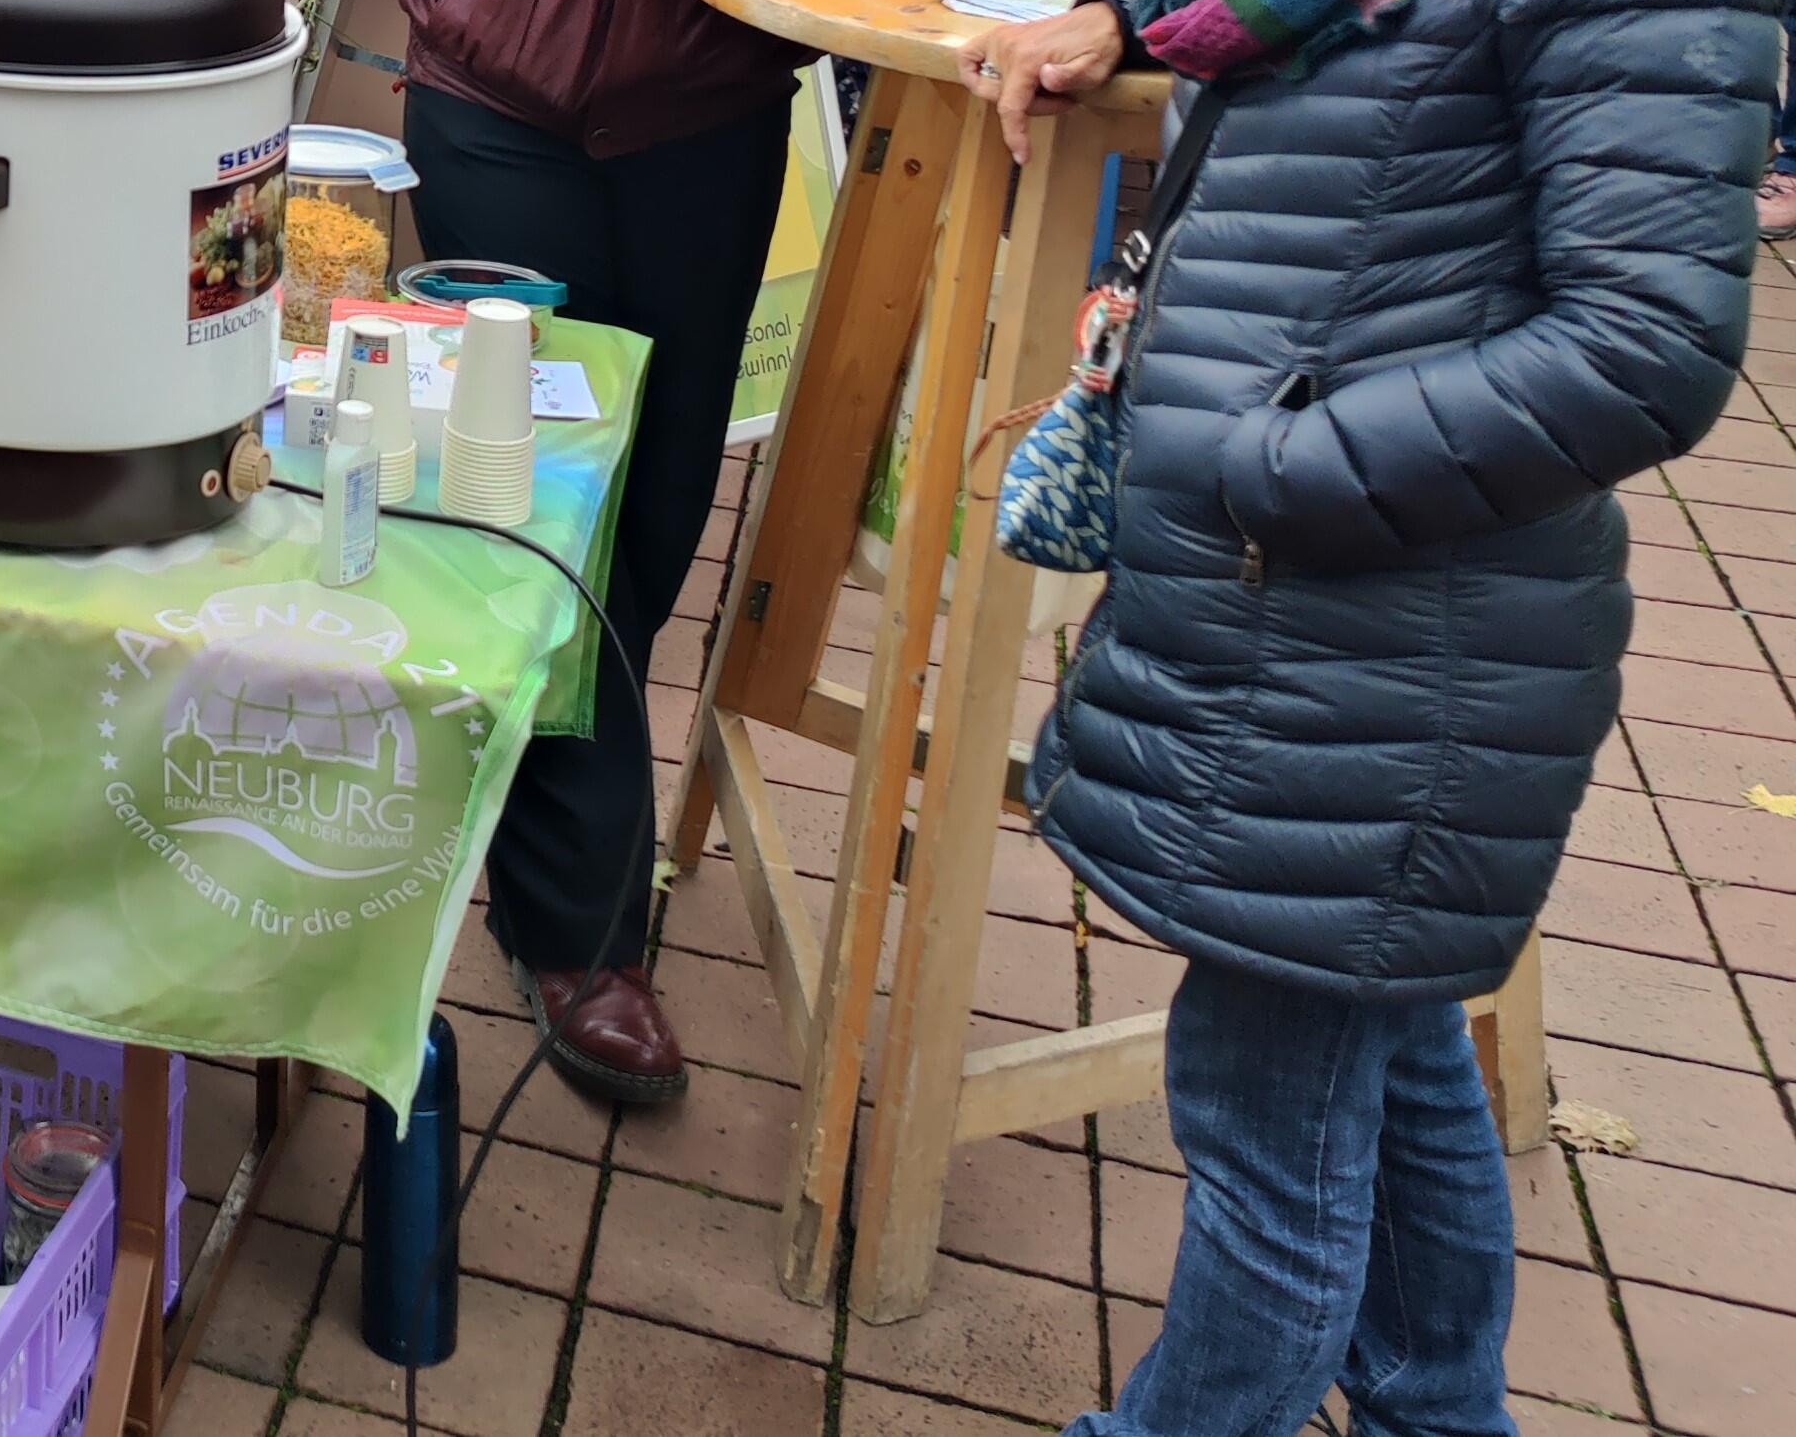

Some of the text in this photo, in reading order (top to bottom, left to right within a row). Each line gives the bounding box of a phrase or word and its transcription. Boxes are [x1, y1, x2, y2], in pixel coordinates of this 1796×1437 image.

[114, 602, 483, 717] AGENDA 21
[164, 757, 414, 833] NEUBURG
[164, 796, 413, 849] RENAISSANCE AN DER DONAU
[106, 781, 242, 917] Gemeinsam
[250, 898, 293, 937] für
[303, 906, 352, 937] die
[360, 879, 423, 919] eine
